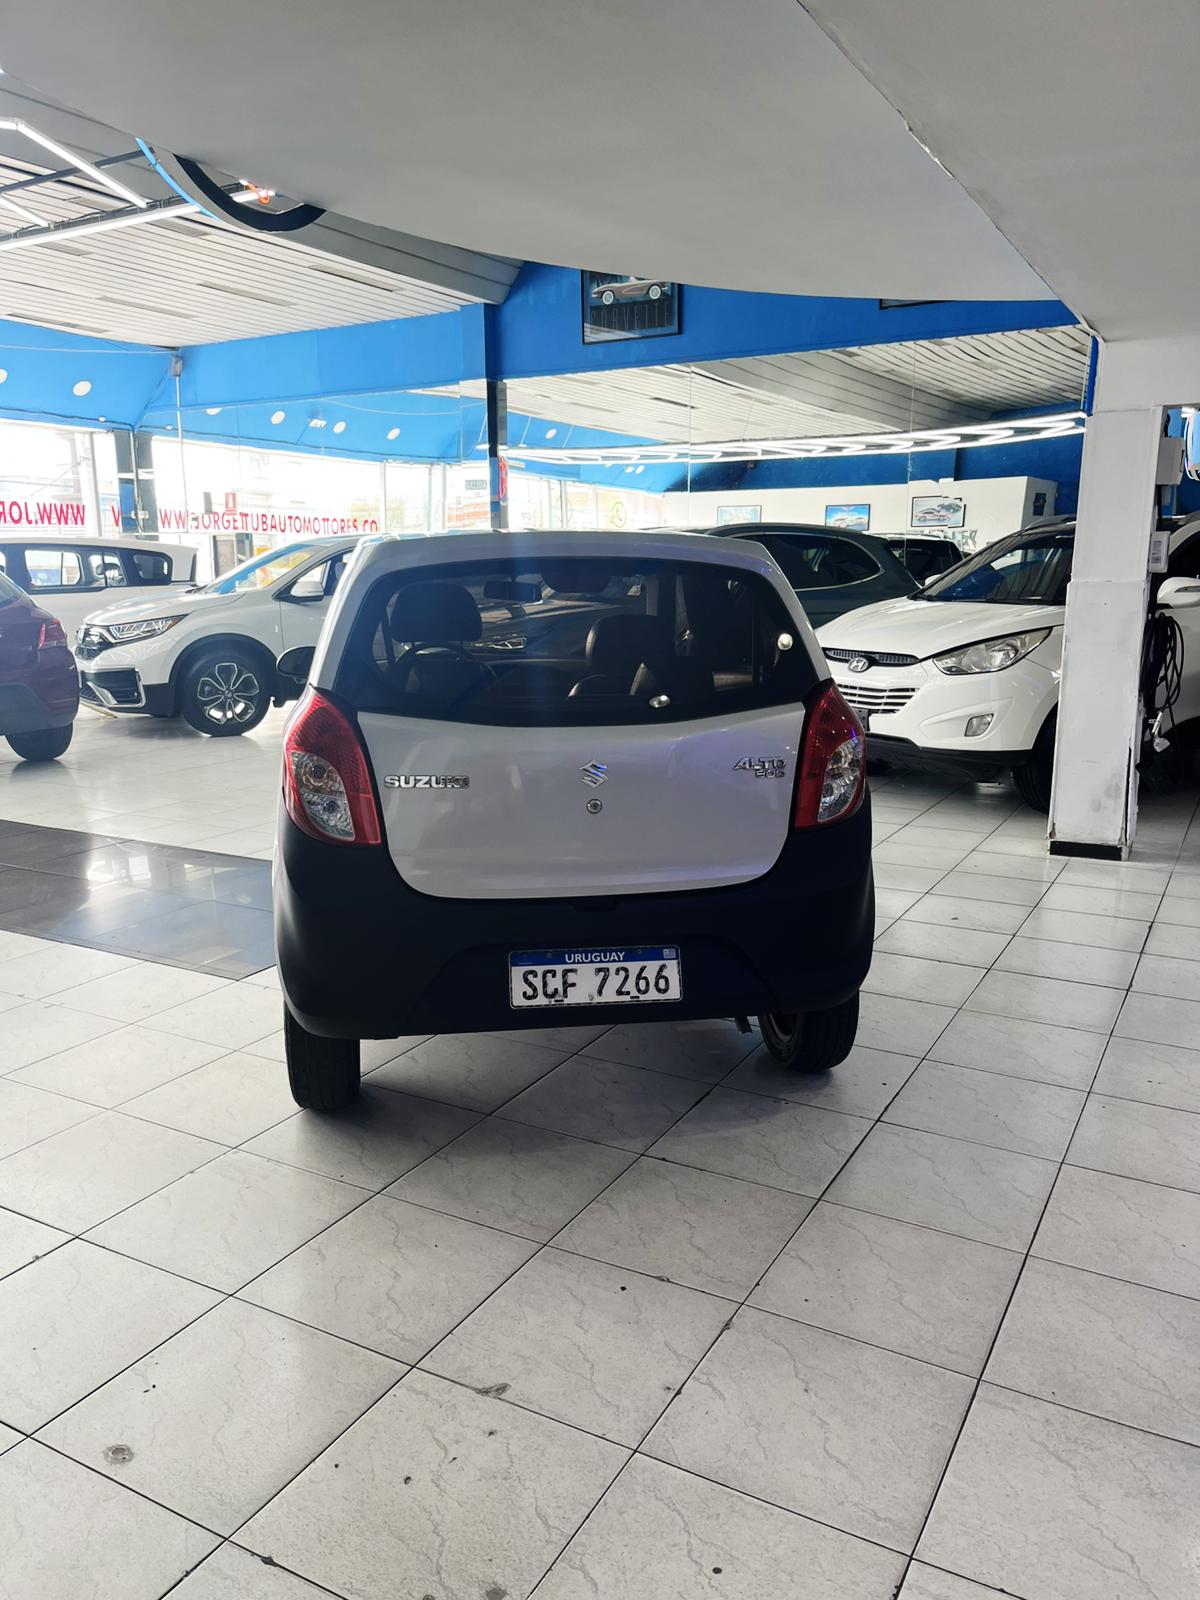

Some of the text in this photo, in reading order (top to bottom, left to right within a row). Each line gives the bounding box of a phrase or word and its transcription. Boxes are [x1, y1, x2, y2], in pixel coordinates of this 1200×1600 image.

[384, 775, 470, 789] SUZUKI
[565, 951, 626, 964] URUGUAY
[522, 963, 670, 1000] SCF 7266
